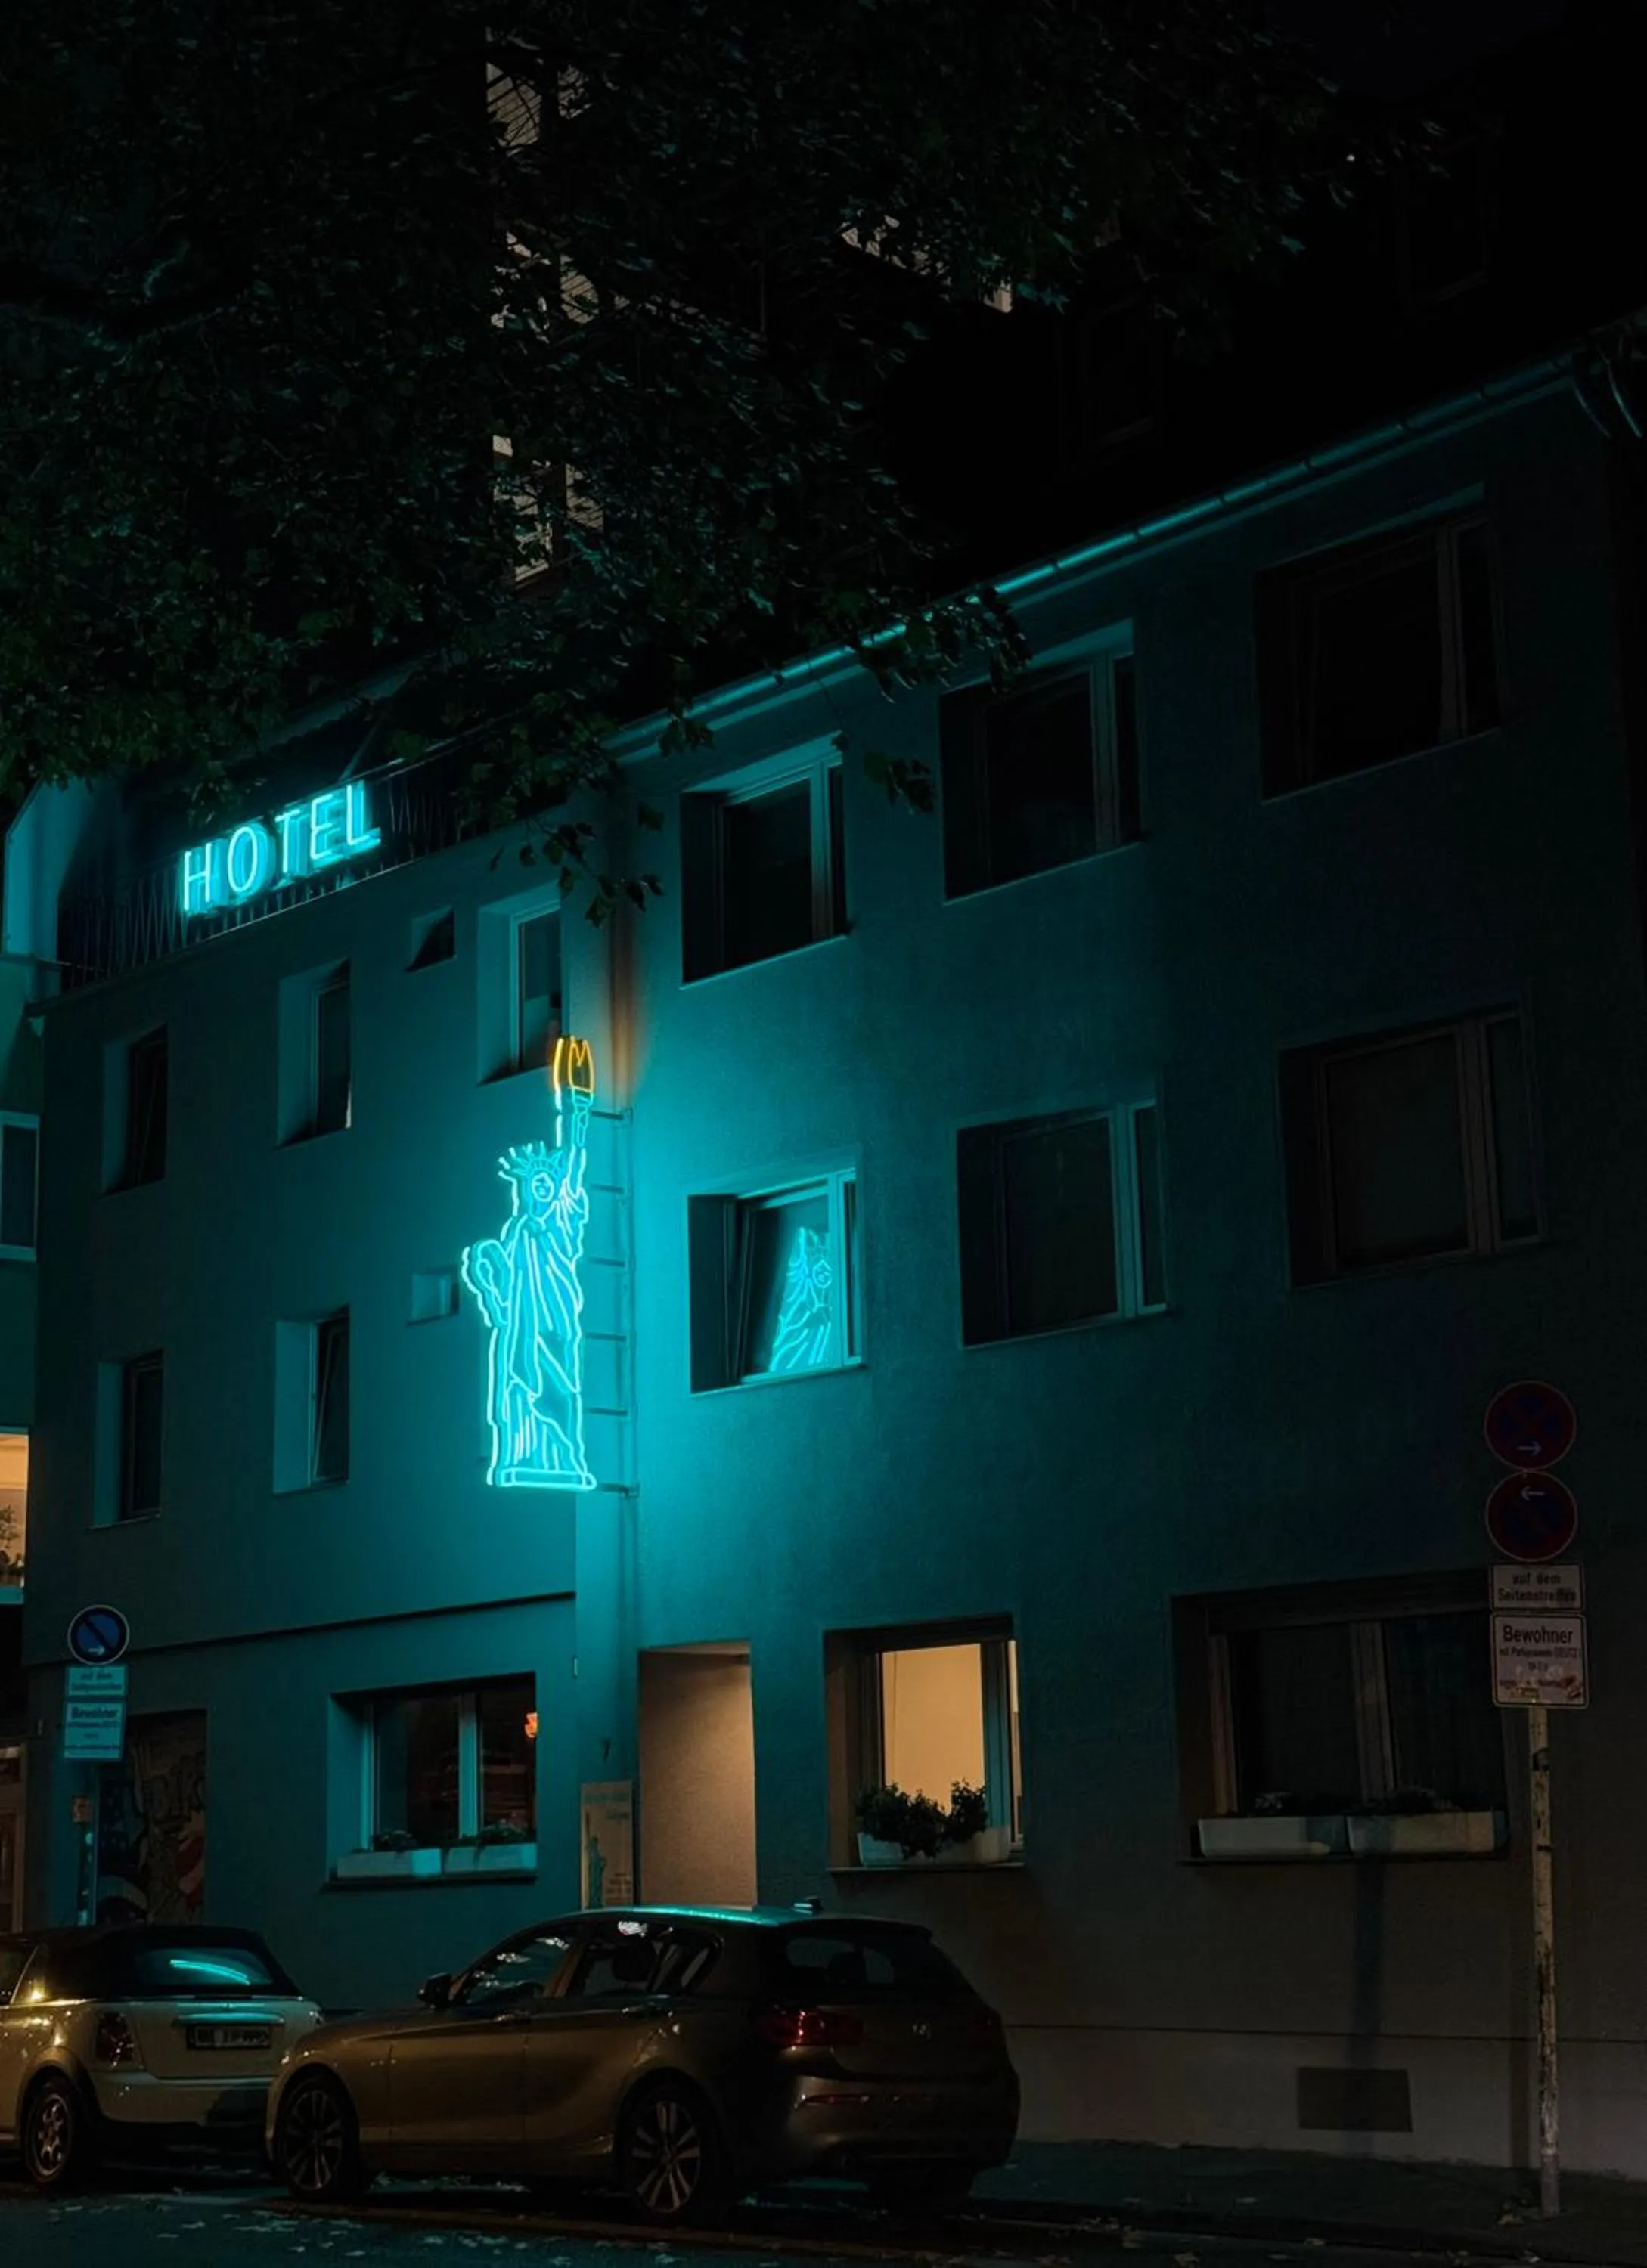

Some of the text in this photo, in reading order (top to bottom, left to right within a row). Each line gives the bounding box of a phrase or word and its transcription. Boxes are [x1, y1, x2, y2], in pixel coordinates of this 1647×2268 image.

[182, 780, 381, 912] HOTEL
[1512, 1572, 1561, 1585] auf dem
[1503, 1625, 1573, 1644] Bewohner
